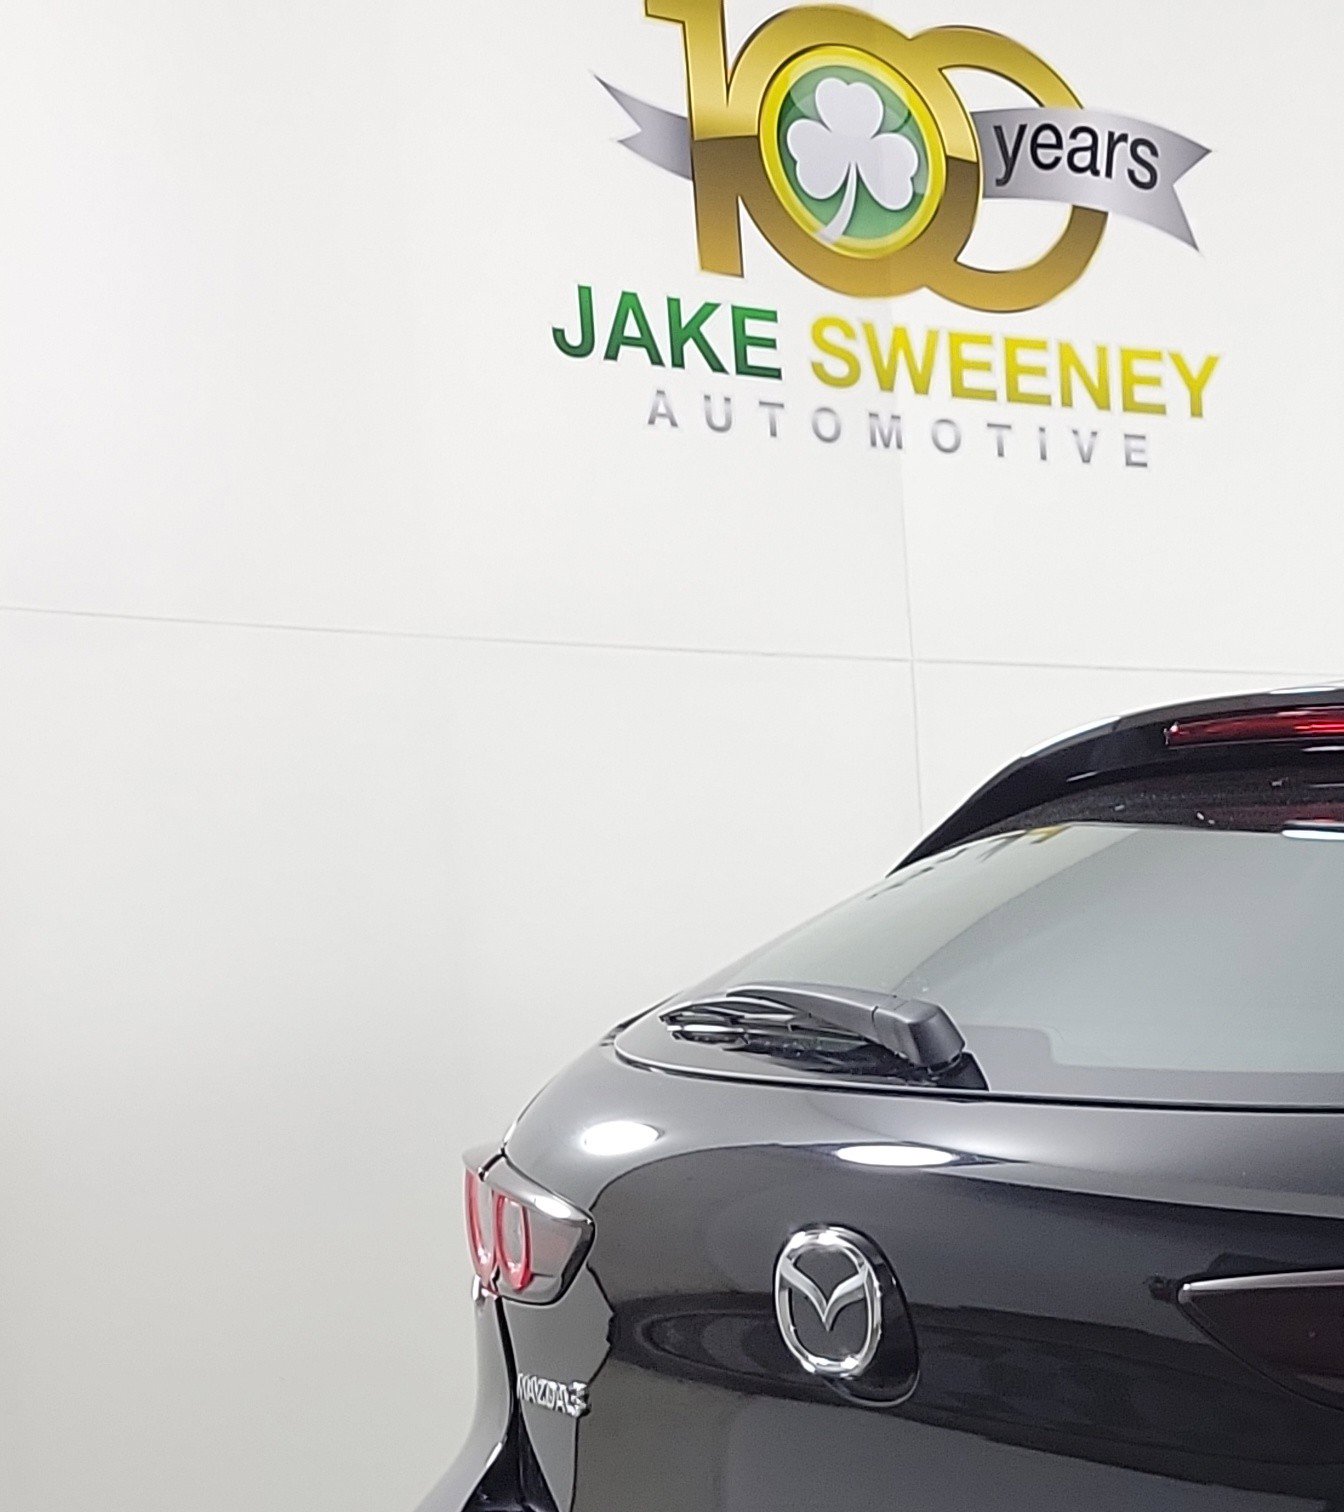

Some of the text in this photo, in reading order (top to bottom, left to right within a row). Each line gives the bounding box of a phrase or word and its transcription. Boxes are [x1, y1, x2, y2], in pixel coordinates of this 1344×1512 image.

[645, 0, 1160, 313] 100 years
[552, 285, 1221, 418] JAKE SWEENEY
[647, 390, 1148, 468] AUTOMOTIVE
